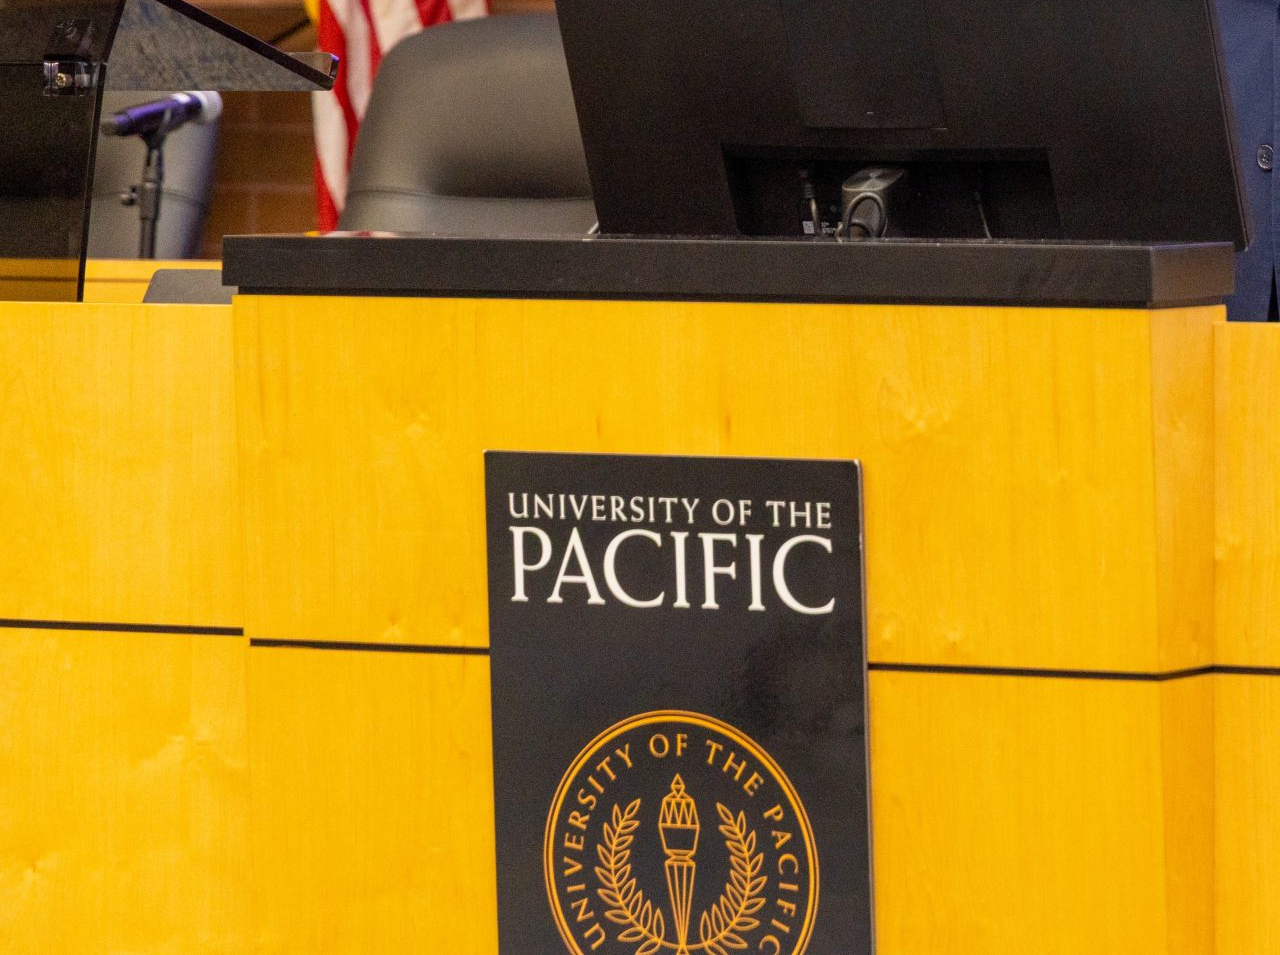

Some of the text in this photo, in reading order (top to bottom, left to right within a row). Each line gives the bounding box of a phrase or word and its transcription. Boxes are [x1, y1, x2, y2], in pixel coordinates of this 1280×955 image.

[507, 492, 832, 530] UNIVERSITY OF THE
[508, 526, 836, 616] PACIFIC
[563, 733, 799, 955] UNIVERSITY OF THE PACIFIC
